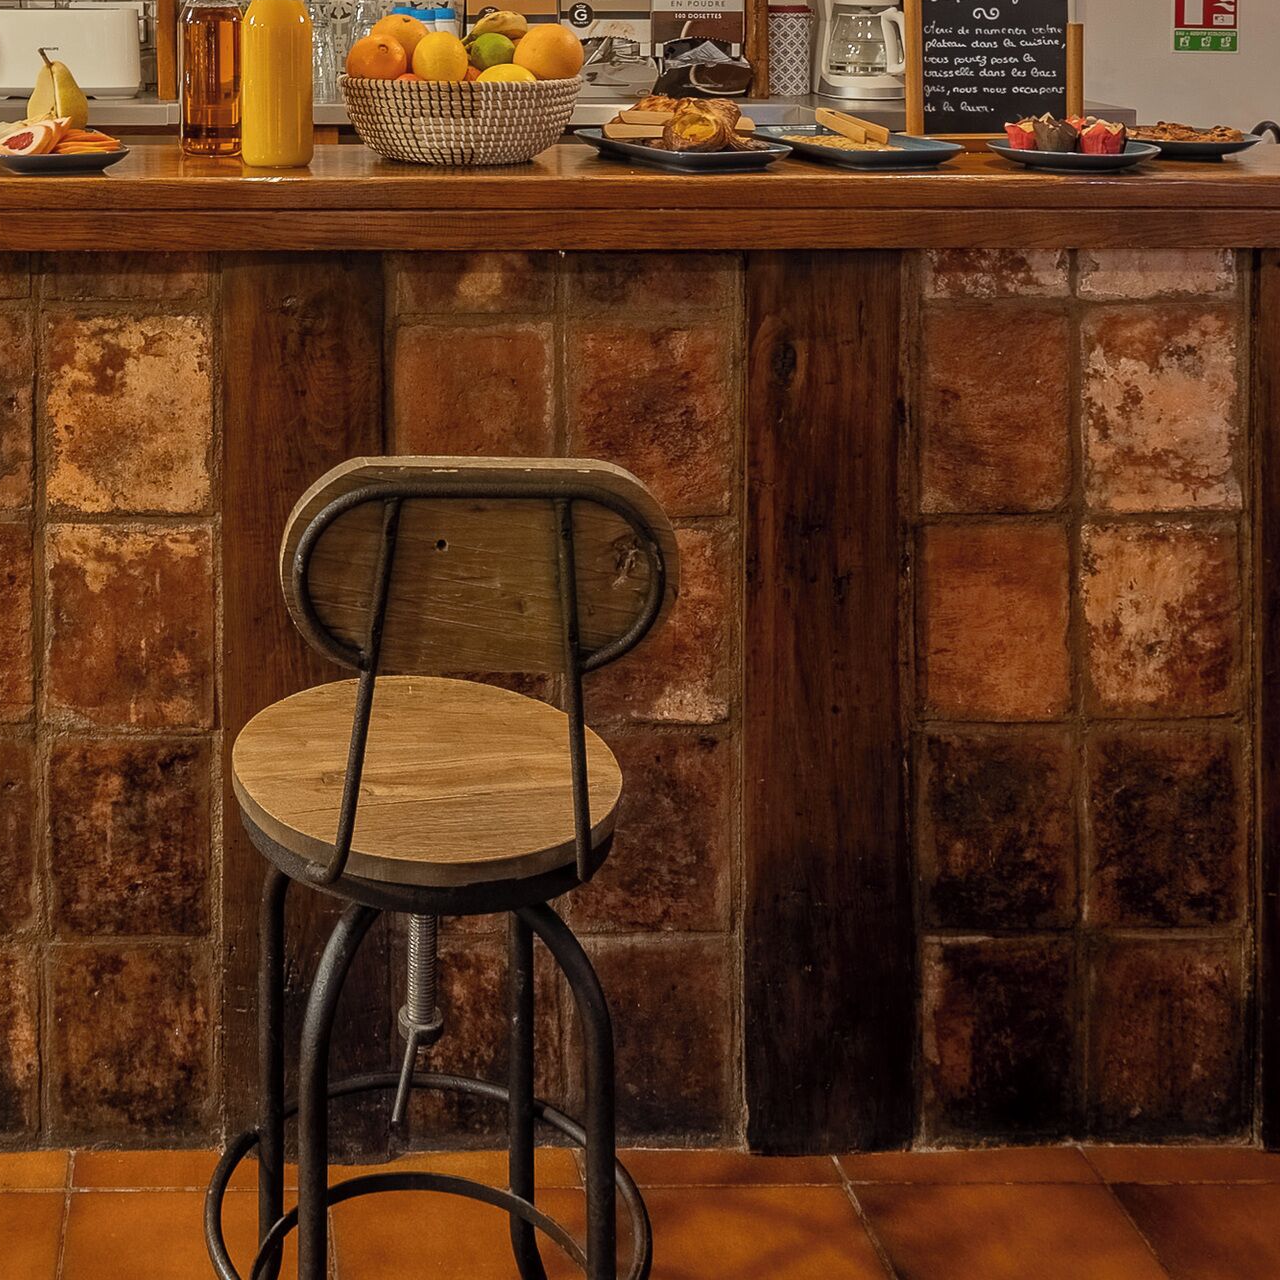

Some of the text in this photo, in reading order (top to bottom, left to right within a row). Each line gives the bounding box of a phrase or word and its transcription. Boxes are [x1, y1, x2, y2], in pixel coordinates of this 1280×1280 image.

[574, 9, 588, 21] G
[924, 20, 953, 34] Merci
[957, 26, 970, 35] de
[1032, 24, 1062, 34] votre
[925, 38, 967, 52] plateau
[971, 40, 999, 48] dans
[1003, 38, 1016, 48] la
[924, 56, 949, 64] vous
[990, 56, 1020, 65] poser
[924, 67, 1057, 77] vaisselle dans les bacs
[952, 86, 978, 94] nous
[983, 86, 1007, 94] nous
[1012, 86, 1065, 95] occupons
[924, 102, 936, 112] de
